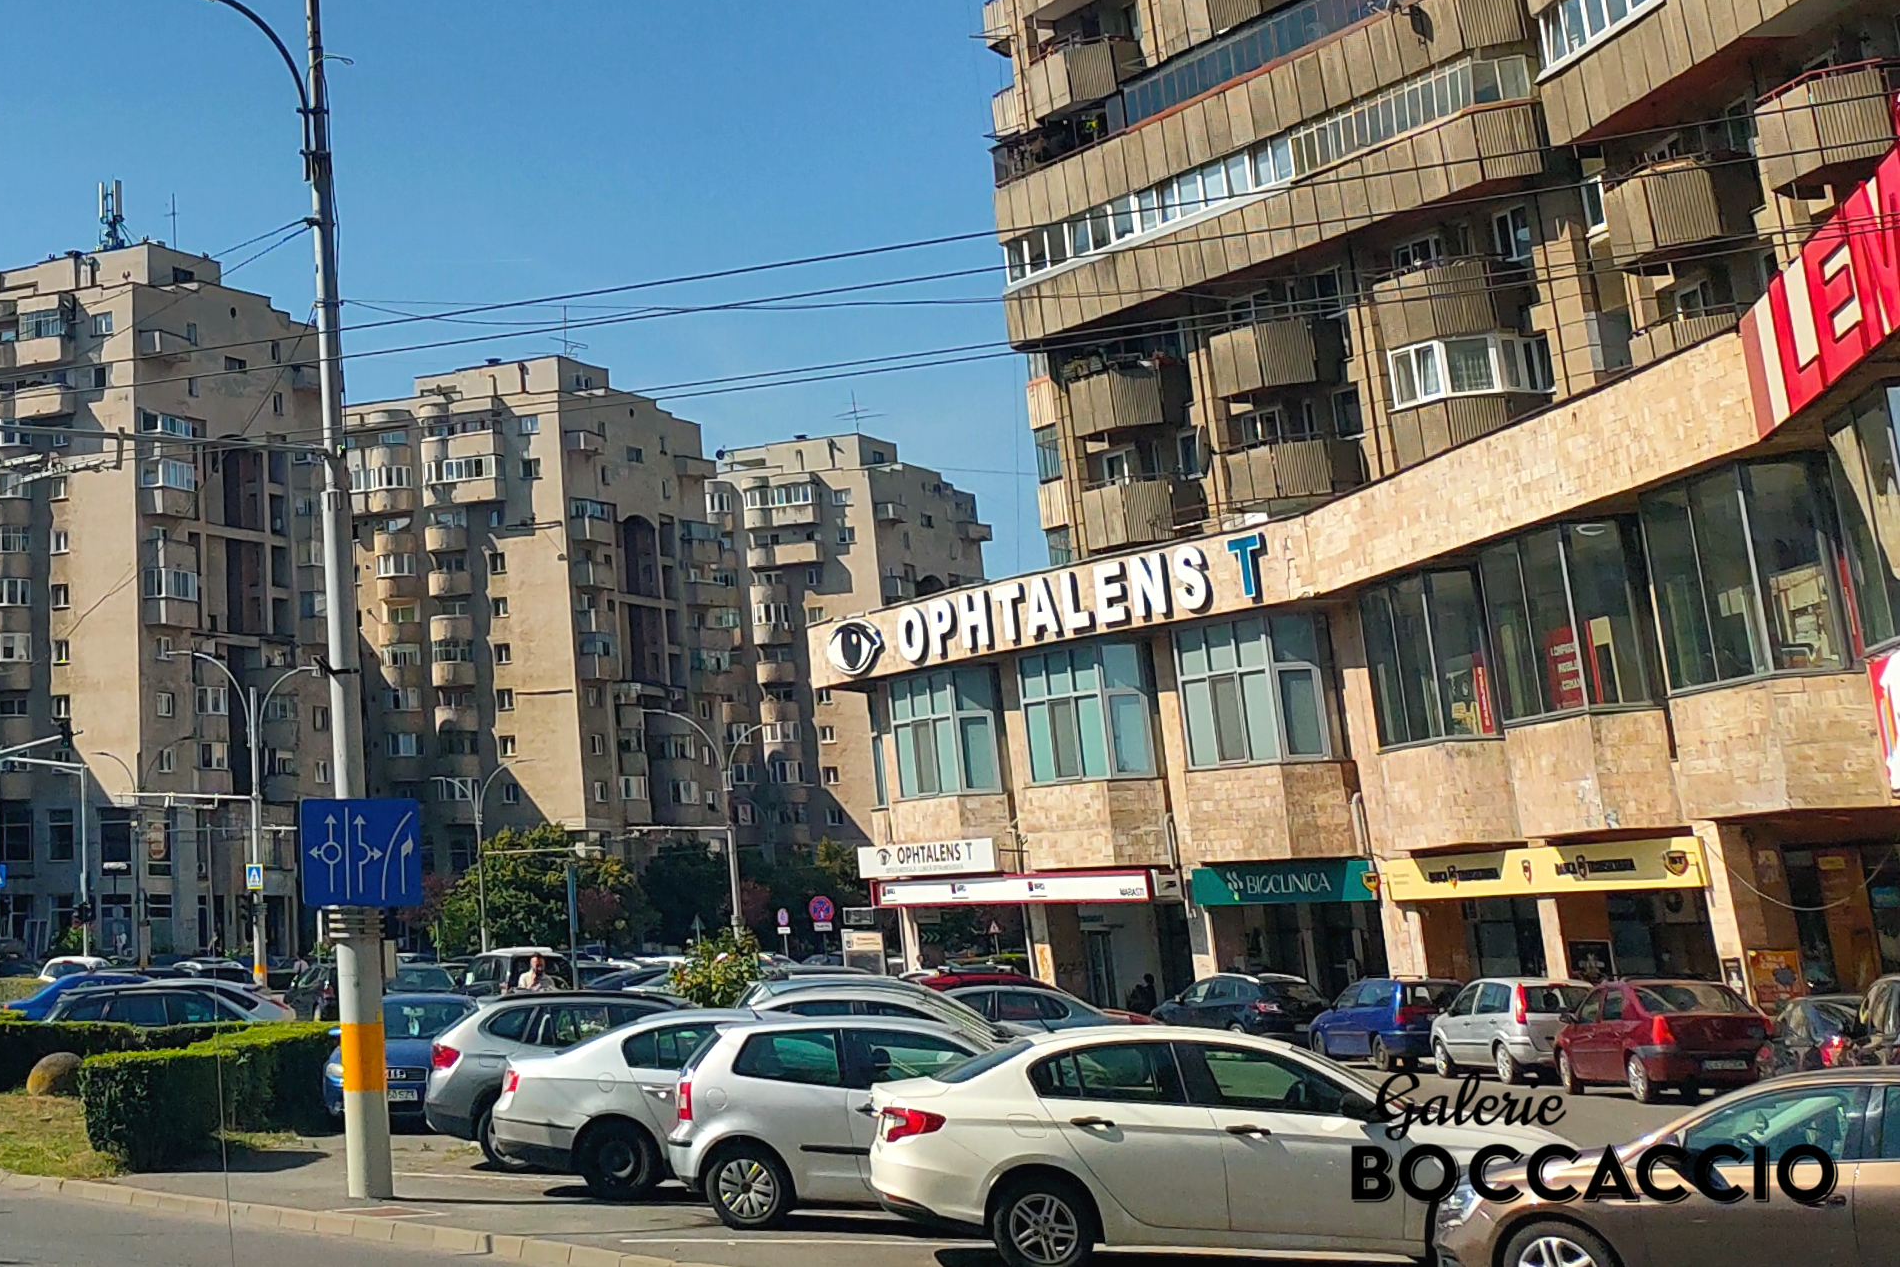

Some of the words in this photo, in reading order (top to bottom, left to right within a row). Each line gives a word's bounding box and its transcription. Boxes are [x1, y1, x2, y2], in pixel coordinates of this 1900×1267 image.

[897, 545, 1209, 663] OPHTALENS
[1226, 534, 1262, 599] T
[897, 842, 961, 865] OPHTALENS
[964, 842, 973, 861] T
[1246, 872, 1331, 895] BIOCLINICA
